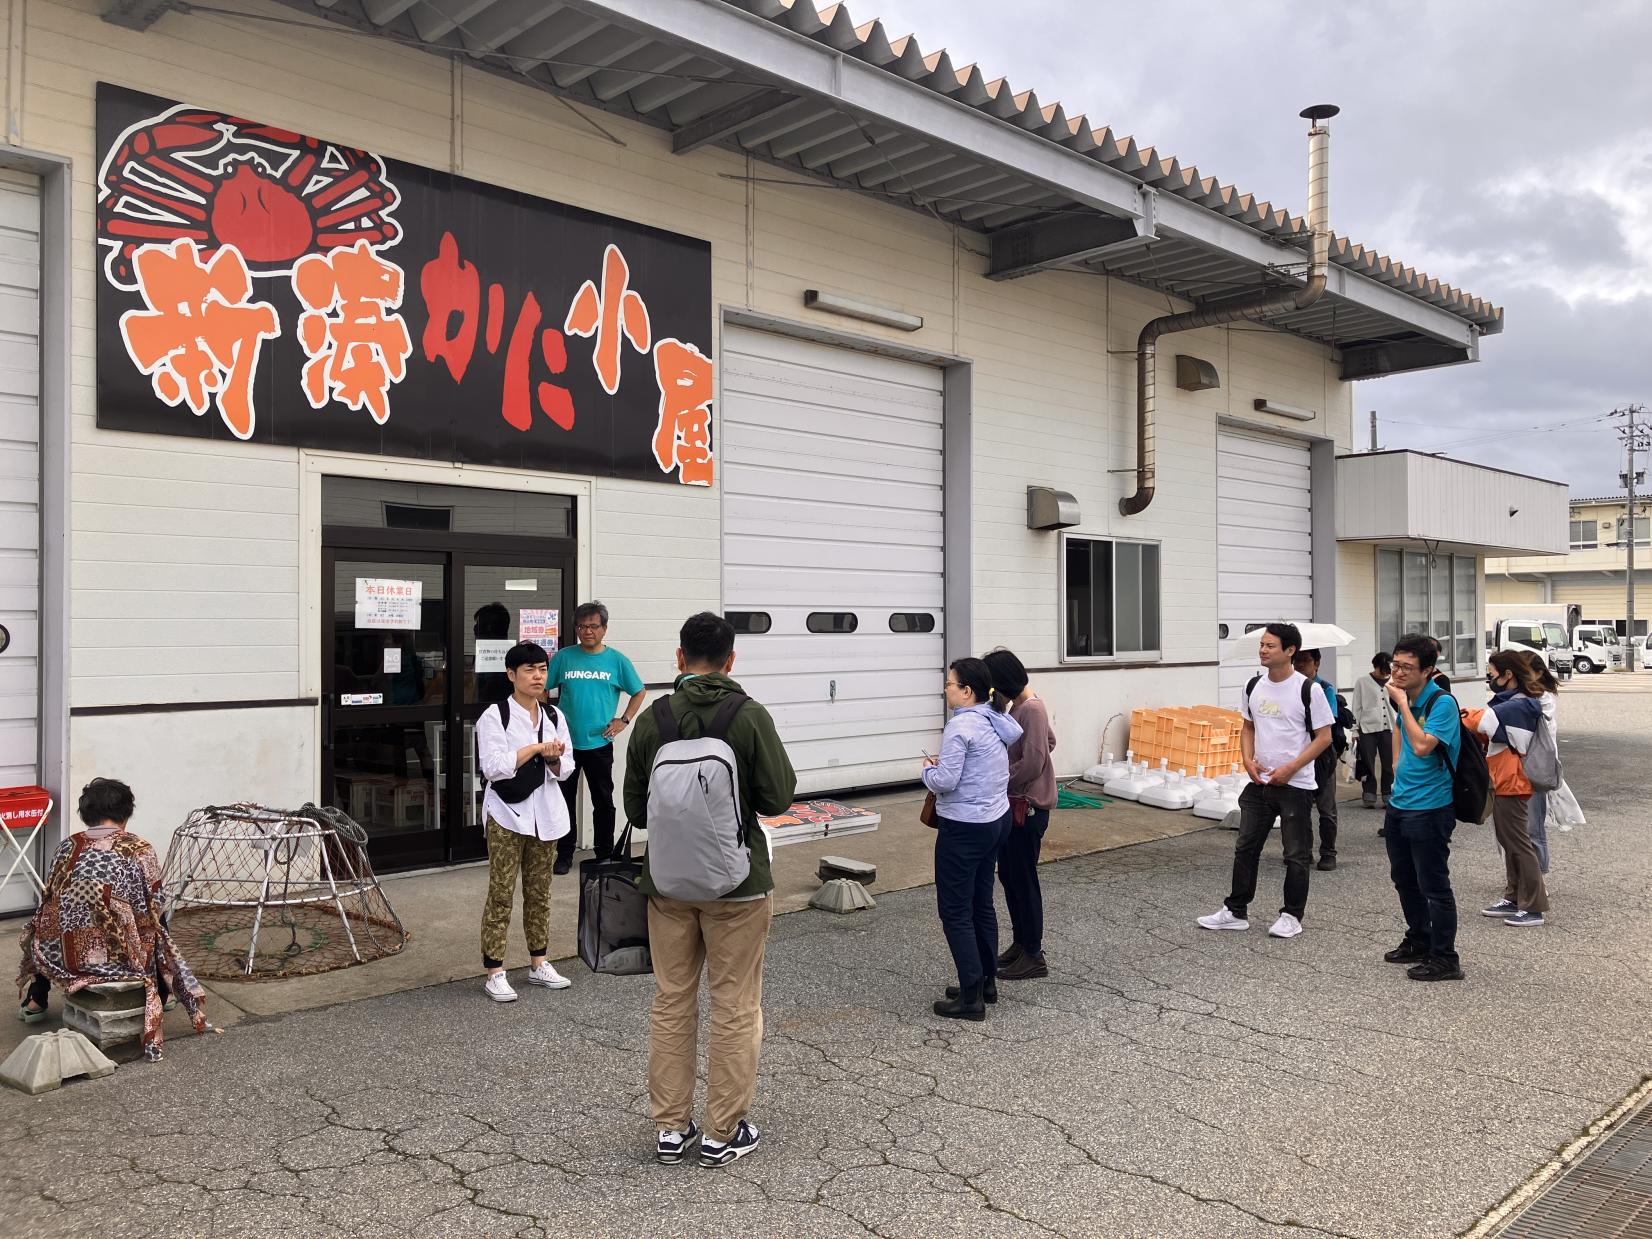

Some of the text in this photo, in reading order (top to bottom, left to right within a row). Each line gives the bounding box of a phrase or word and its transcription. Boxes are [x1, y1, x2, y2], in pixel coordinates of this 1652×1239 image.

[119, 231, 714, 487] 新湊かに小屋
[365, 584, 412, 596] 本日休業日
[564, 670, 612, 681] HUNGARY
